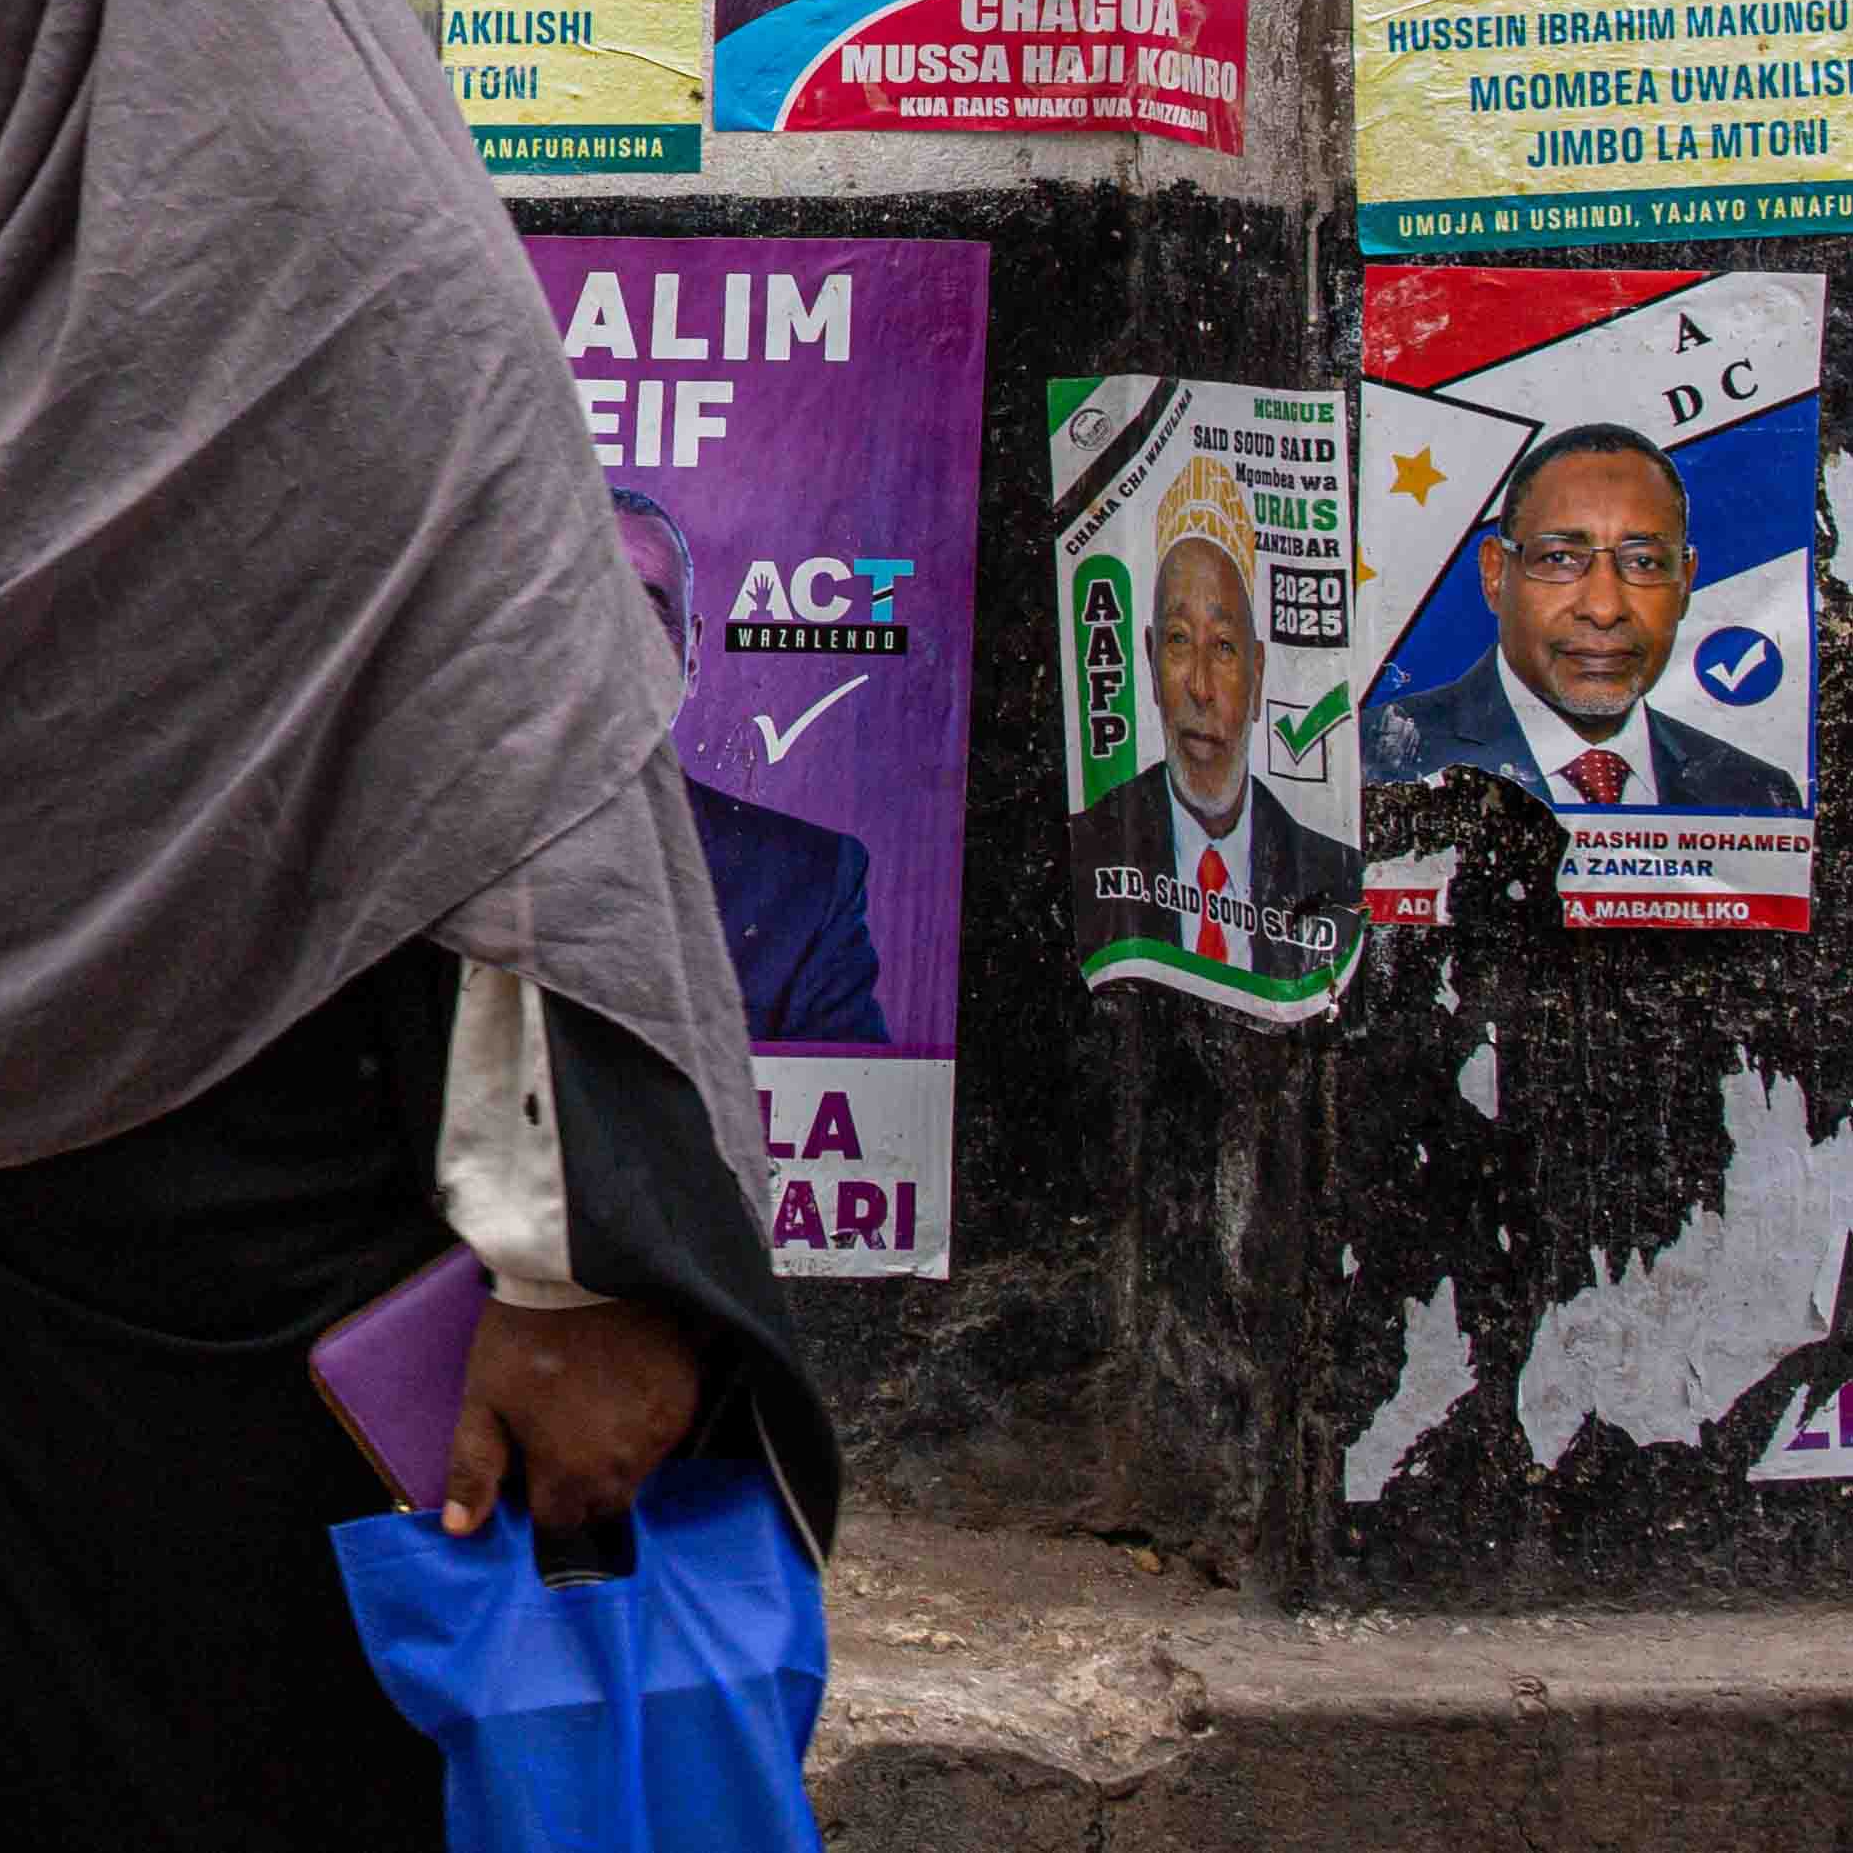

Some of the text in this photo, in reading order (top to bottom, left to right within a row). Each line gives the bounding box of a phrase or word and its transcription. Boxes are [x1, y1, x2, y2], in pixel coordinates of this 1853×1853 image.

[1387, 13, 1527, 54] HUSSEIN
[1537, 5, 1676, 46] IBRAHIM
[841, 44, 1238, 104] MUSSA HAJI KOMBO
[1469, 68, 1658, 113] MGOMBEA
[899, 97, 1133, 119] KUA RAIS WAKO WA
[1526, 117, 1829, 169] JIMBO LA MTONI
[1398, 198, 1746, 238] UMOJA NI USHINDI, YAJAYO
[1253, 397, 1335, 424] MCHAGUE
[1192, 424, 1336, 463] SAID SOUD SAID
[1064, 498, 1122, 556] CHAMA
[1118, 464, 1149, 499] CHA
[1145, 387, 1194, 467] WAKULIMA
[1234, 462, 1338, 491] Mgombea wa
[1253, 492, 1339, 532] URAIS
[1254, 531, 1341, 558] ZANZIBAR
[727, 556, 915, 624] ACT
[1273, 573, 1342, 605] 2020
[737, 627, 895, 650] WAZALENDO
[1273, 604, 1343, 637] 2025
[1575, 830, 1811, 854] RASHID MOHAMED
[1587, 858, 1714, 878] ZANZIBAR
[1094, 866, 1258, 936] ND. SAID SOUD
[1595, 900, 1751, 921] MABADILIKO
